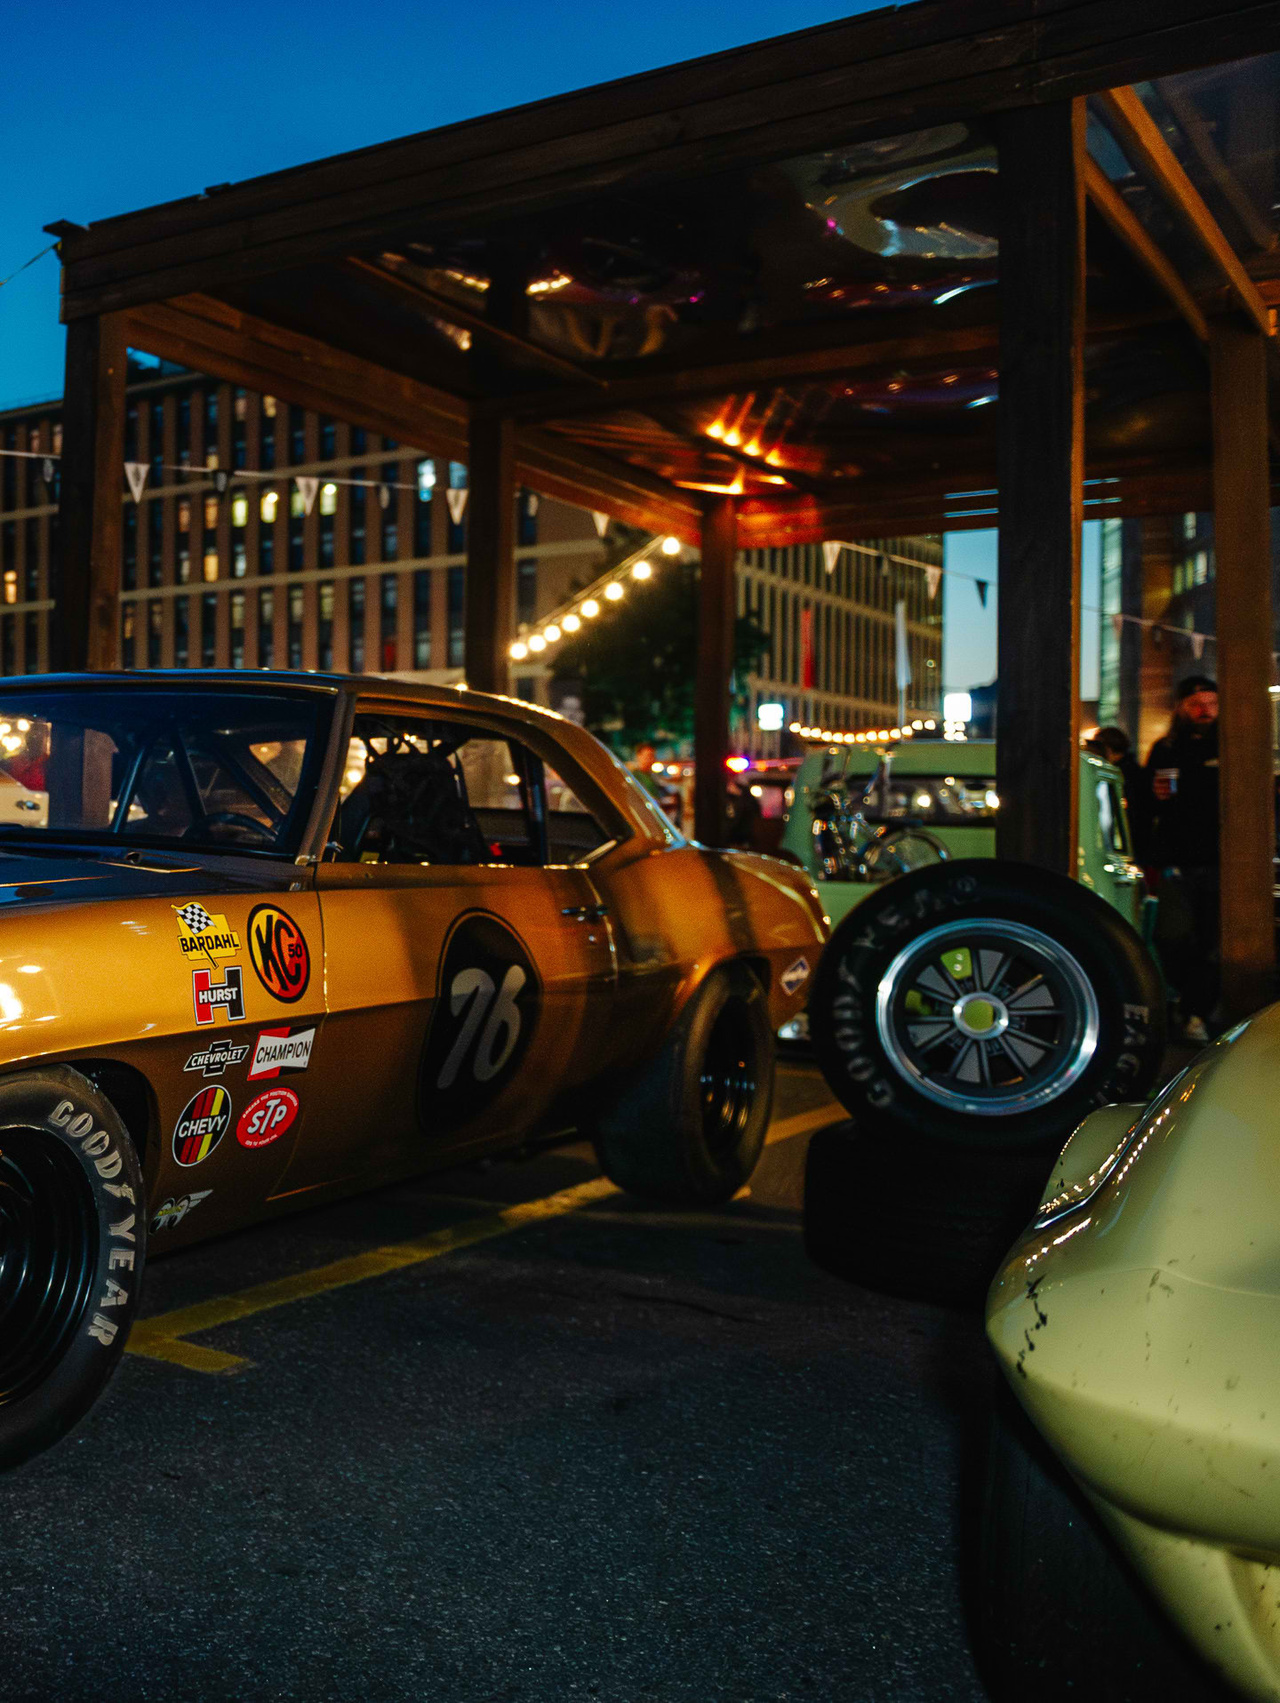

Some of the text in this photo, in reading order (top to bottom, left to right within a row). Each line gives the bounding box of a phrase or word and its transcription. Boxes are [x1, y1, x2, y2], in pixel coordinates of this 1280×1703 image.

[180, 933, 240, 952] BARDAHL
[255, 914, 302, 991] KC
[287, 943, 303, 959] 50
[198, 987, 239, 1005] HURST
[437, 964, 527, 1090] 76
[190, 1048, 245, 1067] CHEVROLET
[256, 1041, 312, 1064] CHAMPION
[177, 1114, 227, 1139] CHEVY
[246, 1098, 288, 1135] STP
[48, 1099, 137, 1348] GOODYEAR
